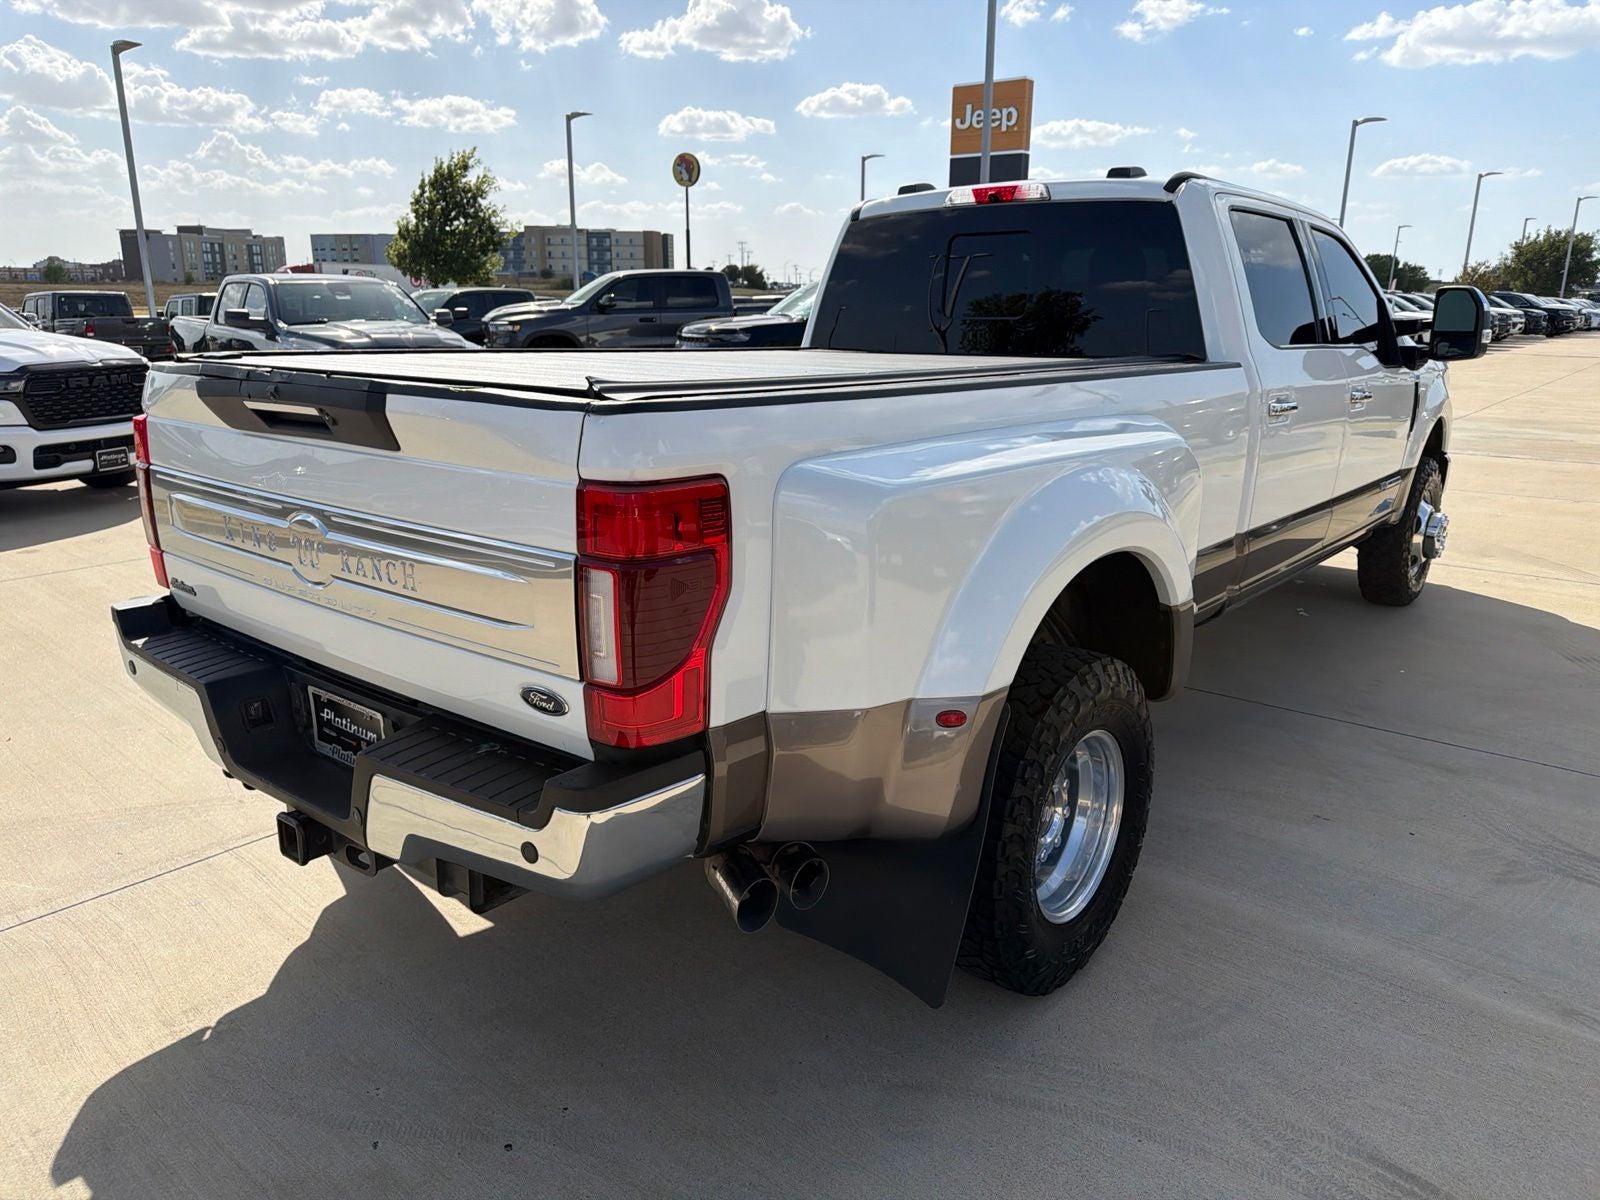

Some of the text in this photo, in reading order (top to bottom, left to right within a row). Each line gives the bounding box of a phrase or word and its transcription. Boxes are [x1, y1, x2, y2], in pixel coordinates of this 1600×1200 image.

[955, 103, 1018, 132] Jeep
[68, 373, 128, 388] RAM
[223, 513, 418, 593] KING RANCH
[528, 691, 556, 712] Ford
[320, 708, 378, 743] Platinum
[329, 744, 356, 765] Plati
